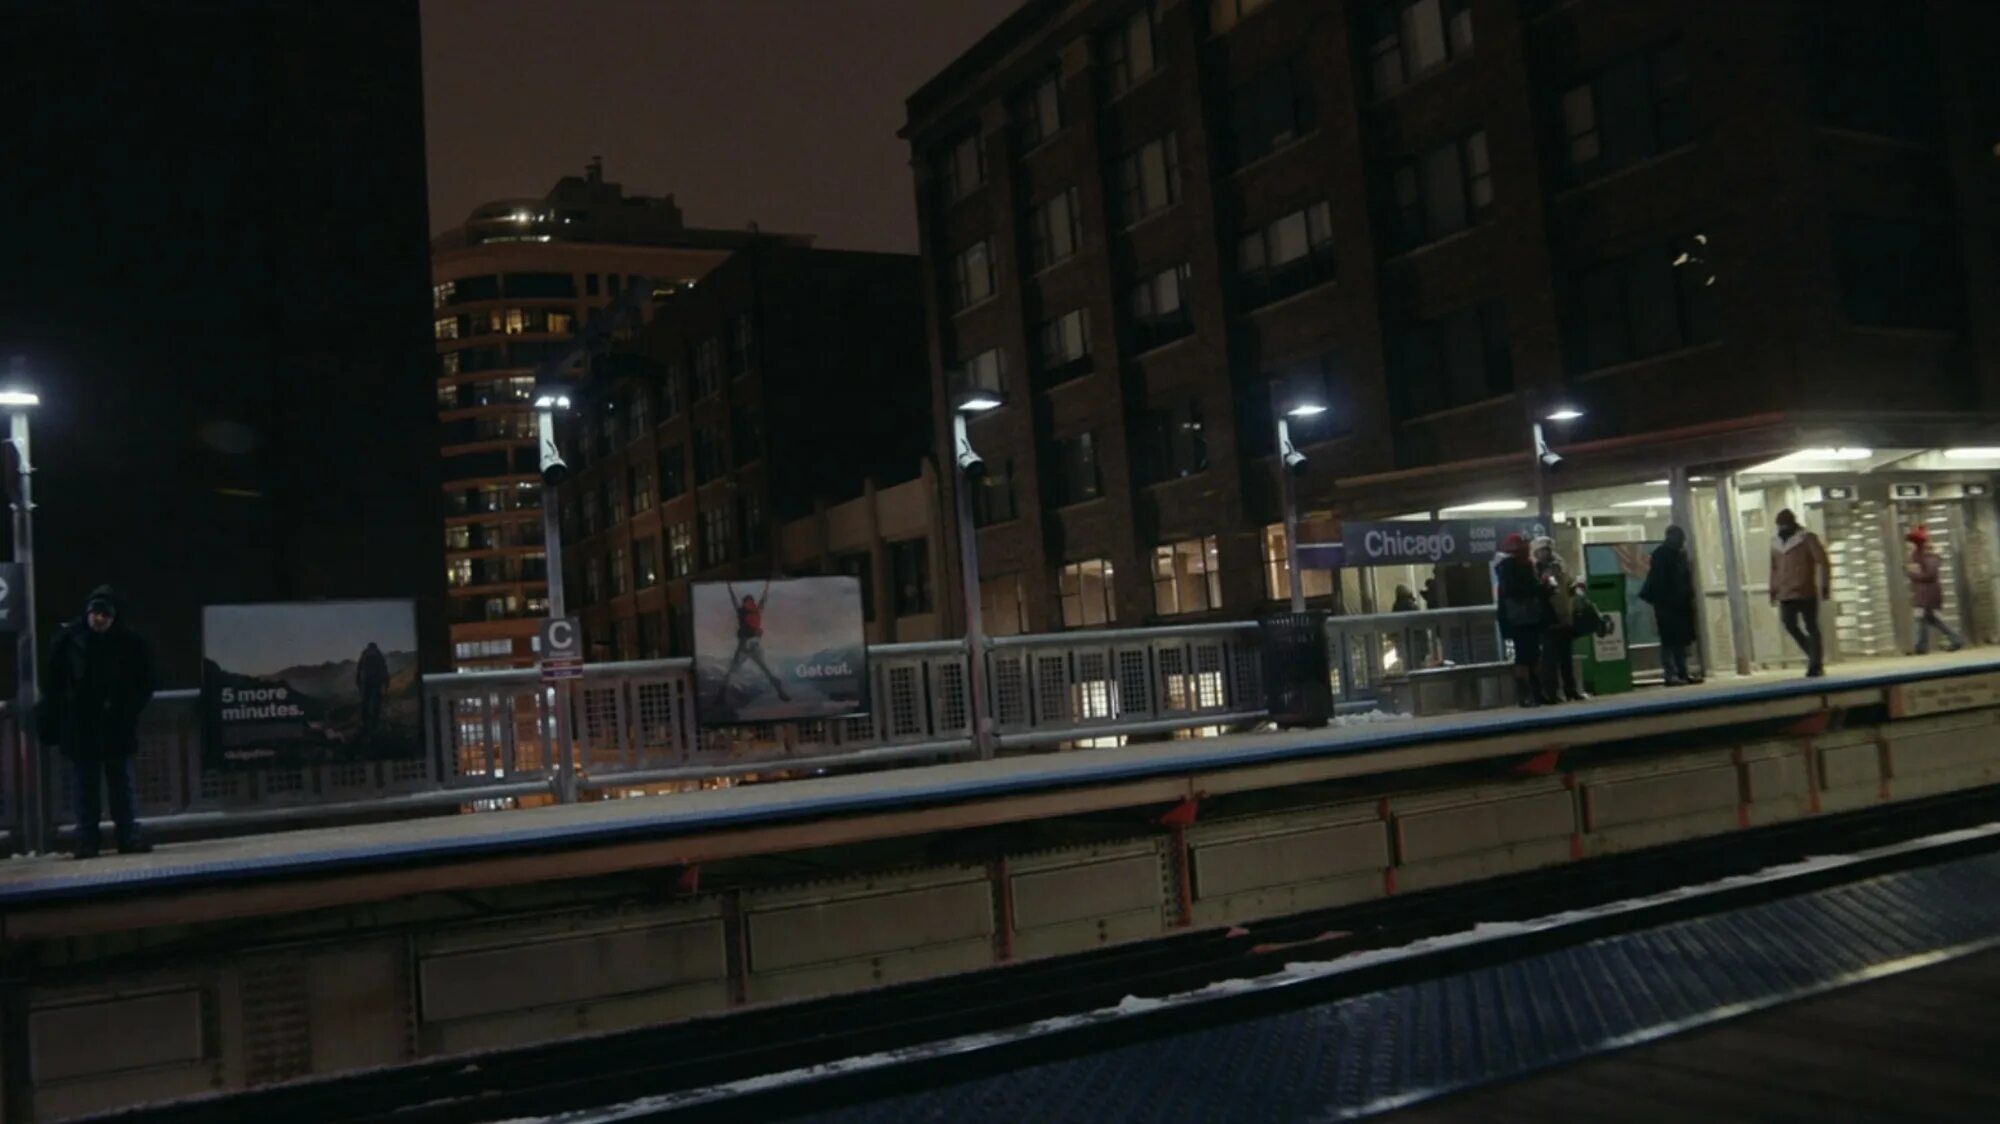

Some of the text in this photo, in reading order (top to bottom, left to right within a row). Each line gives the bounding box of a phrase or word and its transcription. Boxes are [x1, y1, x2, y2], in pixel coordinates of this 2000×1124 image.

[1365, 529, 1455, 560] Chicago
[549, 621, 572, 648] C
[825, 661, 852, 676] out.
[222, 687, 288, 703] 5 more
[222, 702, 304, 720] minutes.
